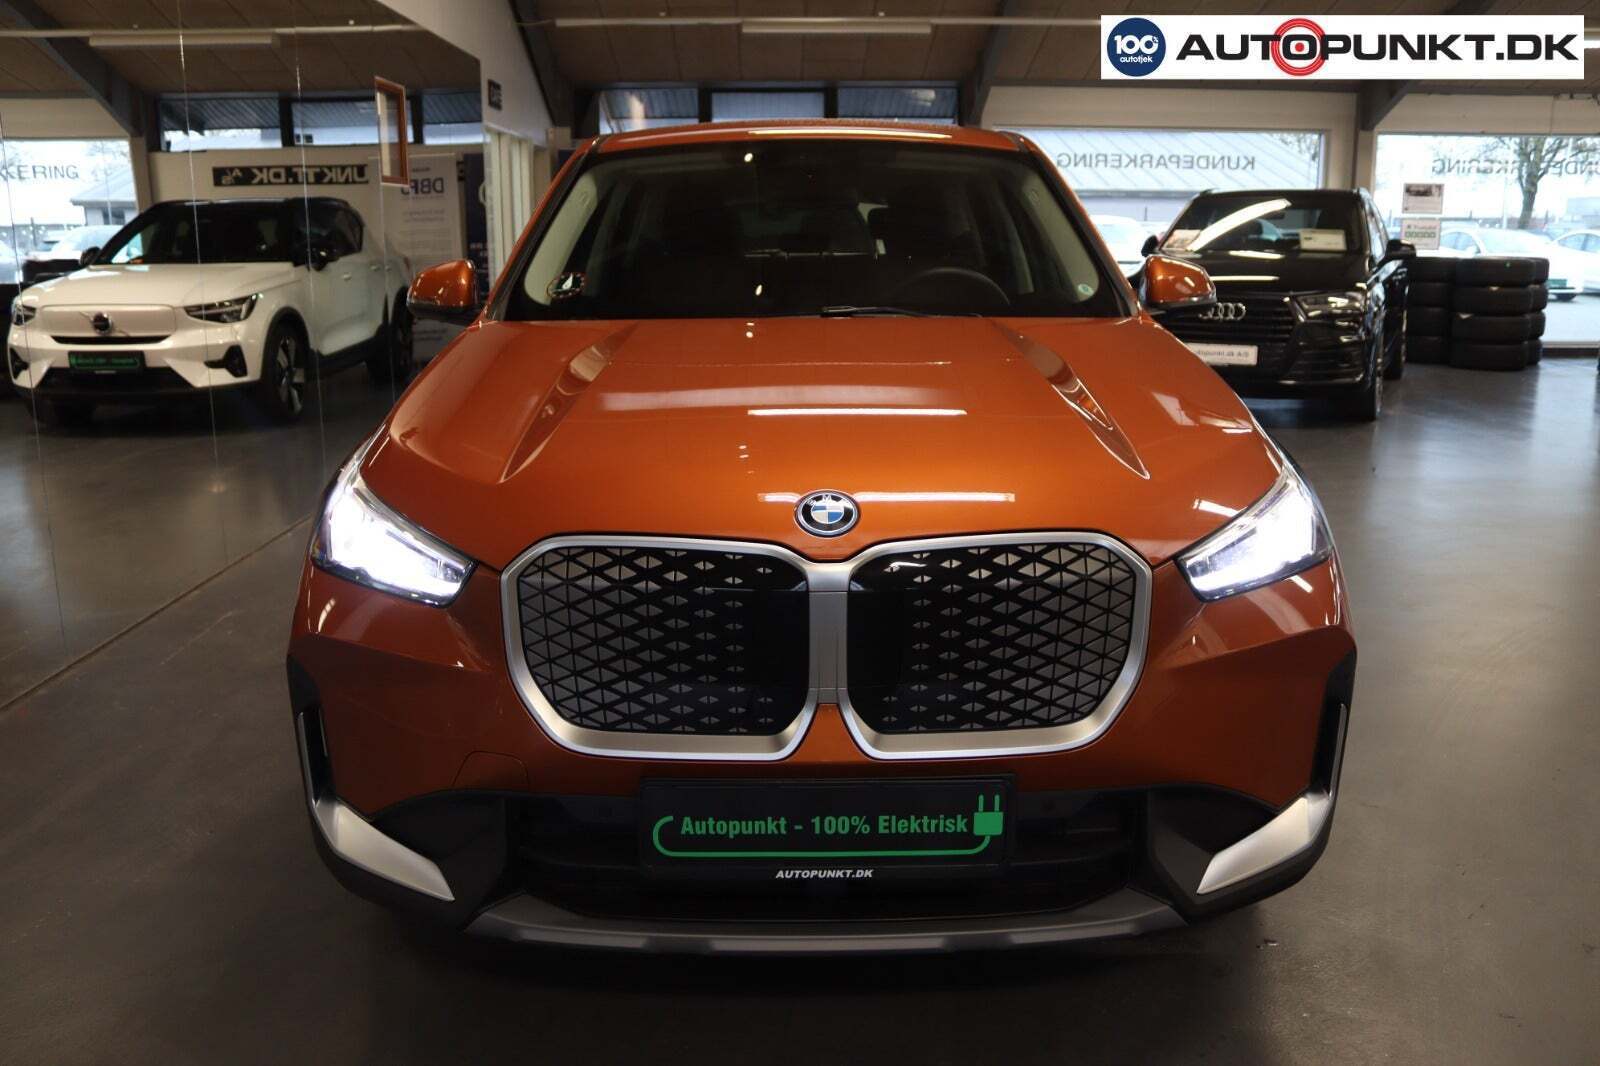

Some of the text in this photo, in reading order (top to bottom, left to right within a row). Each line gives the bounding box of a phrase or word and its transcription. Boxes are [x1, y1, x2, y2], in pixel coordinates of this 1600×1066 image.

[680, 815, 787, 839] Autopunkt
[811, 815, 871, 835] 100%
[878, 814, 968, 835] Elektrisk
[775, 868, 874, 880] AUTOPUNKT.DK
